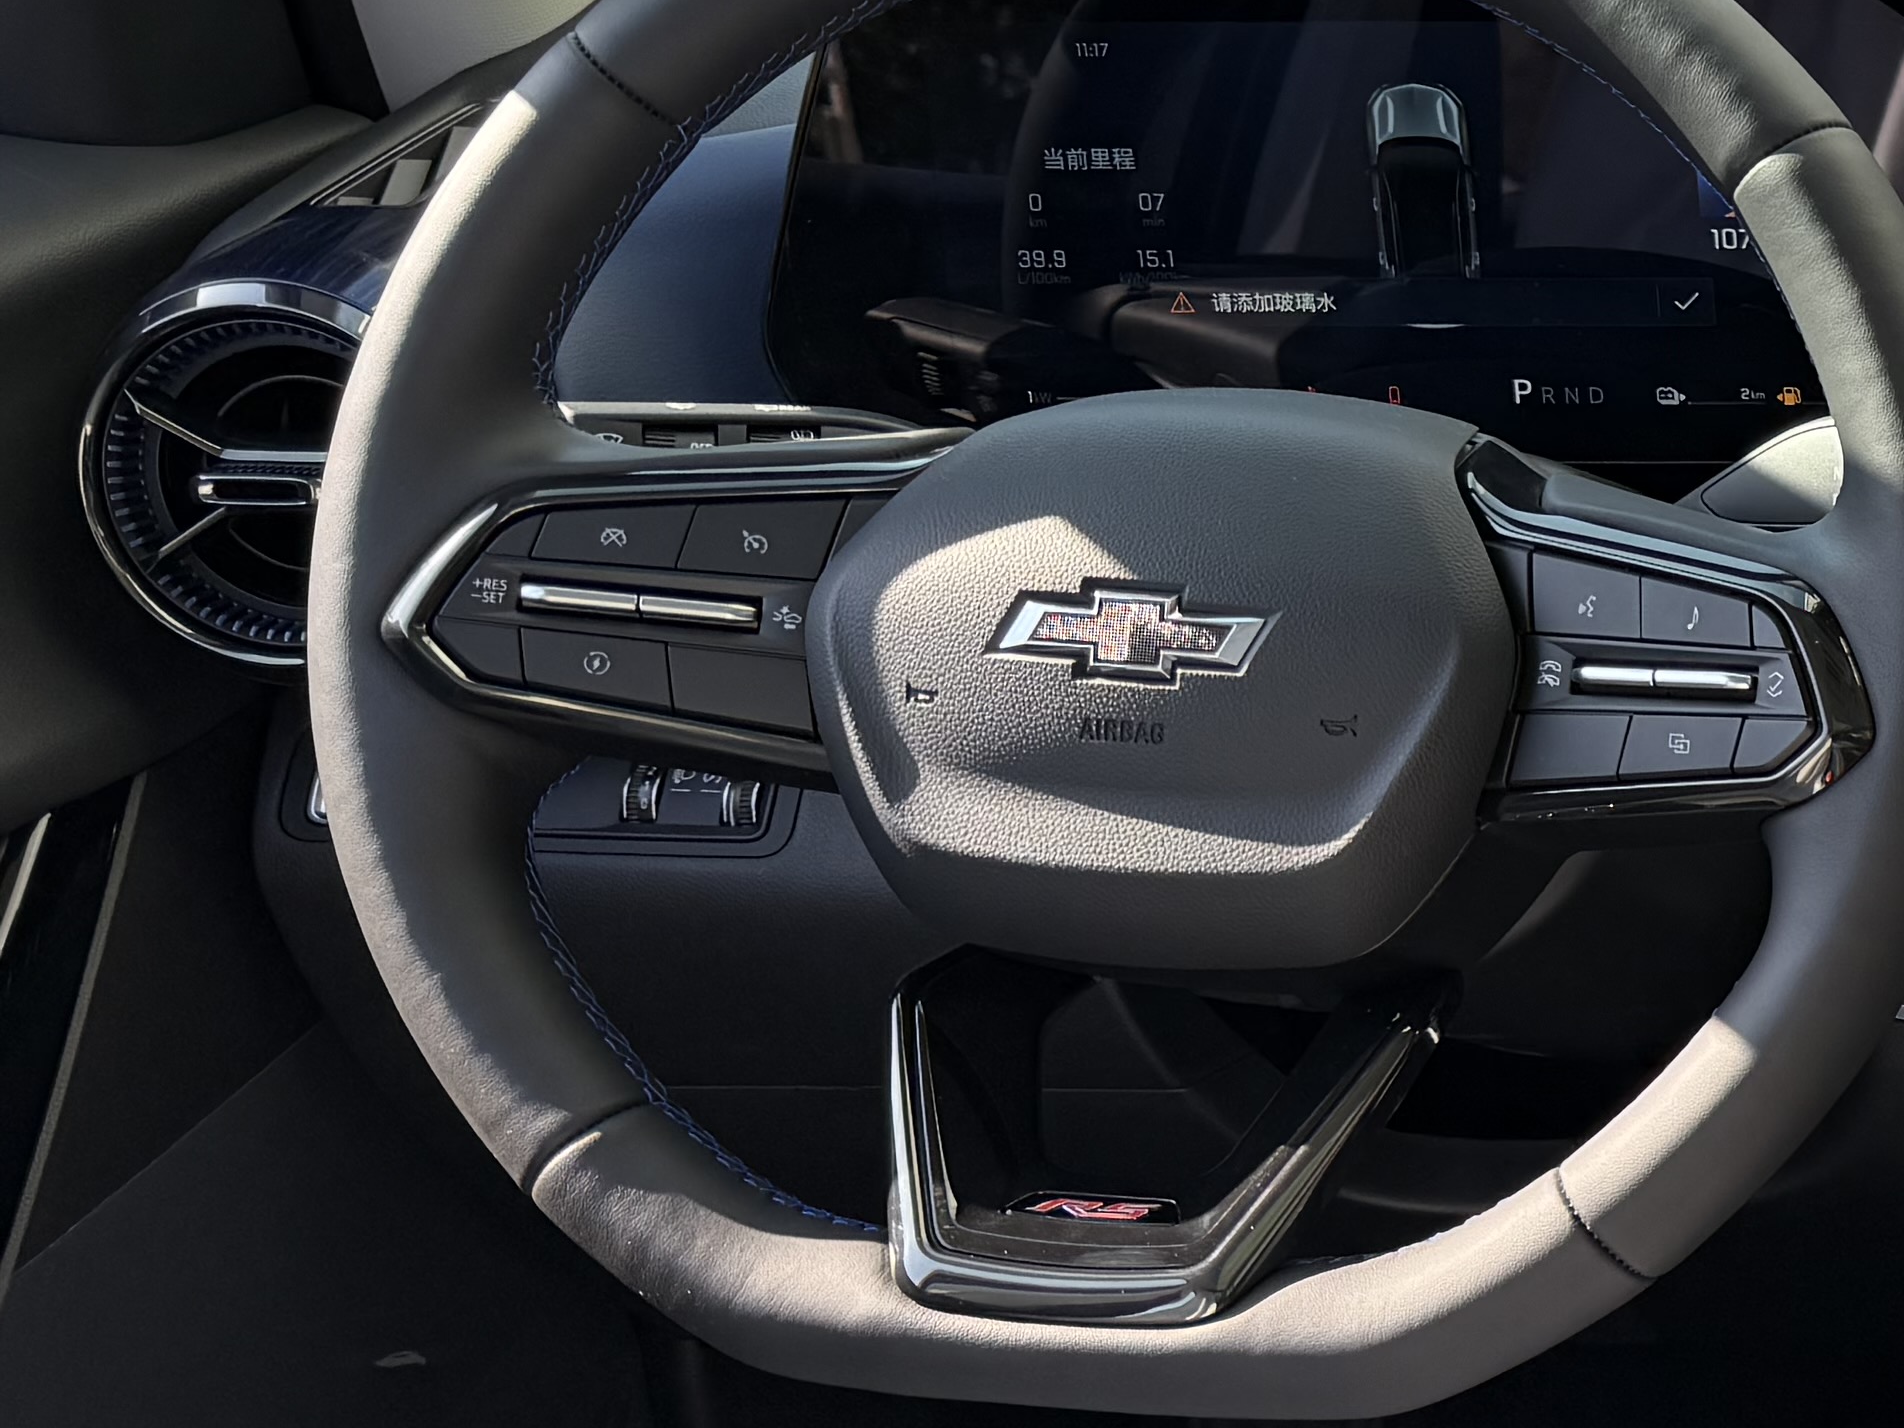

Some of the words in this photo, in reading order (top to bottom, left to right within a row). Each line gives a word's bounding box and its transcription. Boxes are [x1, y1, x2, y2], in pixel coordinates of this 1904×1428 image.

[1075, 43, 1109, 58] 11:17
[1043, 148, 1136, 171] 当前里程
[1028, 193, 1042, 212] 0
[1138, 193, 1165, 212] 07
[1017, 249, 1067, 269] 39.9
[1136, 249, 1175, 269] 15.1
[1211, 291, 1338, 315] 请添加玻璃水
[1512, 379, 1532, 404] P
[1542, 387, 1555, 404] R
[1565, 387, 1580, 404] N
[1589, 386, 1604, 404] D
[1079, 717, 1165, 745] AIRBAG
[1026, 1198, 1160, 1221] RS
